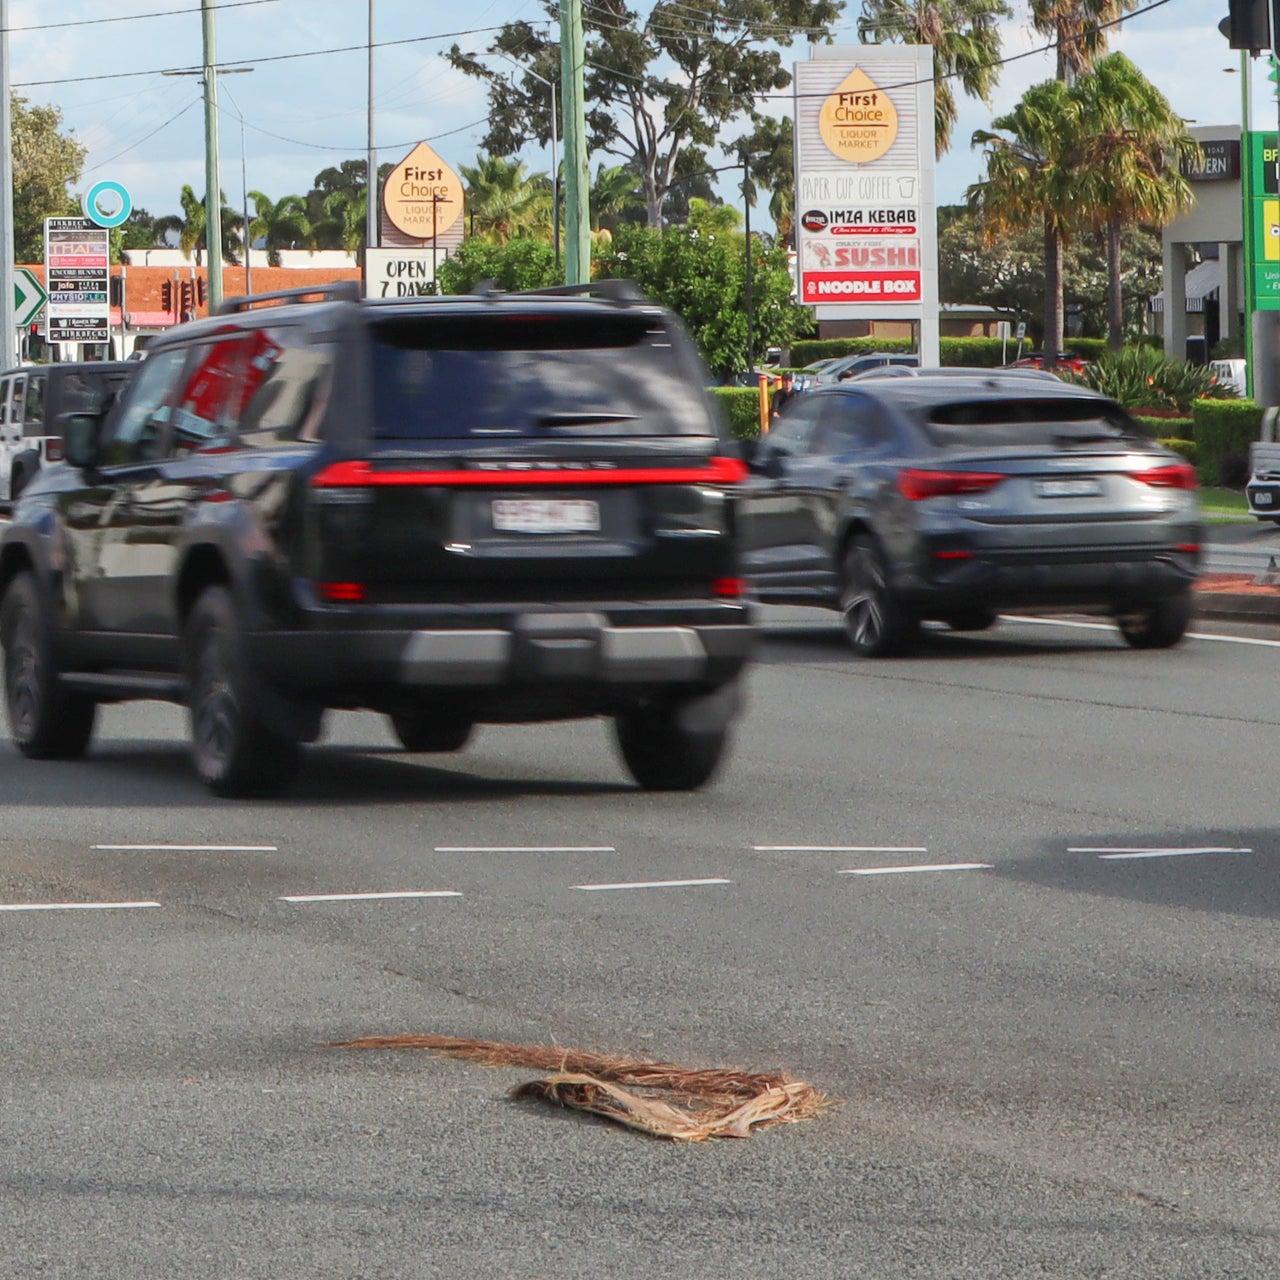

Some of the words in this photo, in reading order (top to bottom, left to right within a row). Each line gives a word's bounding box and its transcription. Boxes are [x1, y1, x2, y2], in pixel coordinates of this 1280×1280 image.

[839, 92, 878, 106] First
[835, 106, 884, 122] Choice
[841, 129, 878, 139] LIQUOR
[838, 139, 880, 149] MARKET
[404, 166, 443, 181] First
[400, 182, 449, 197] Choice
[802, 176, 831, 201] PAPER
[836, 176, 854, 201] CUP
[858, 176, 892, 201] COFFEE
[403, 215, 444, 225] MARKT
[830, 210, 863, 224] IMZA
[868, 209, 917, 224] KEBAB
[51, 243, 90, 255] THAI
[834, 247, 917, 267] SUSHI
[386, 260, 426, 278] OPEN
[380, 281, 390, 298] 7
[818, 280, 881, 295] NOODLE
[883, 280, 917, 294] BOX
